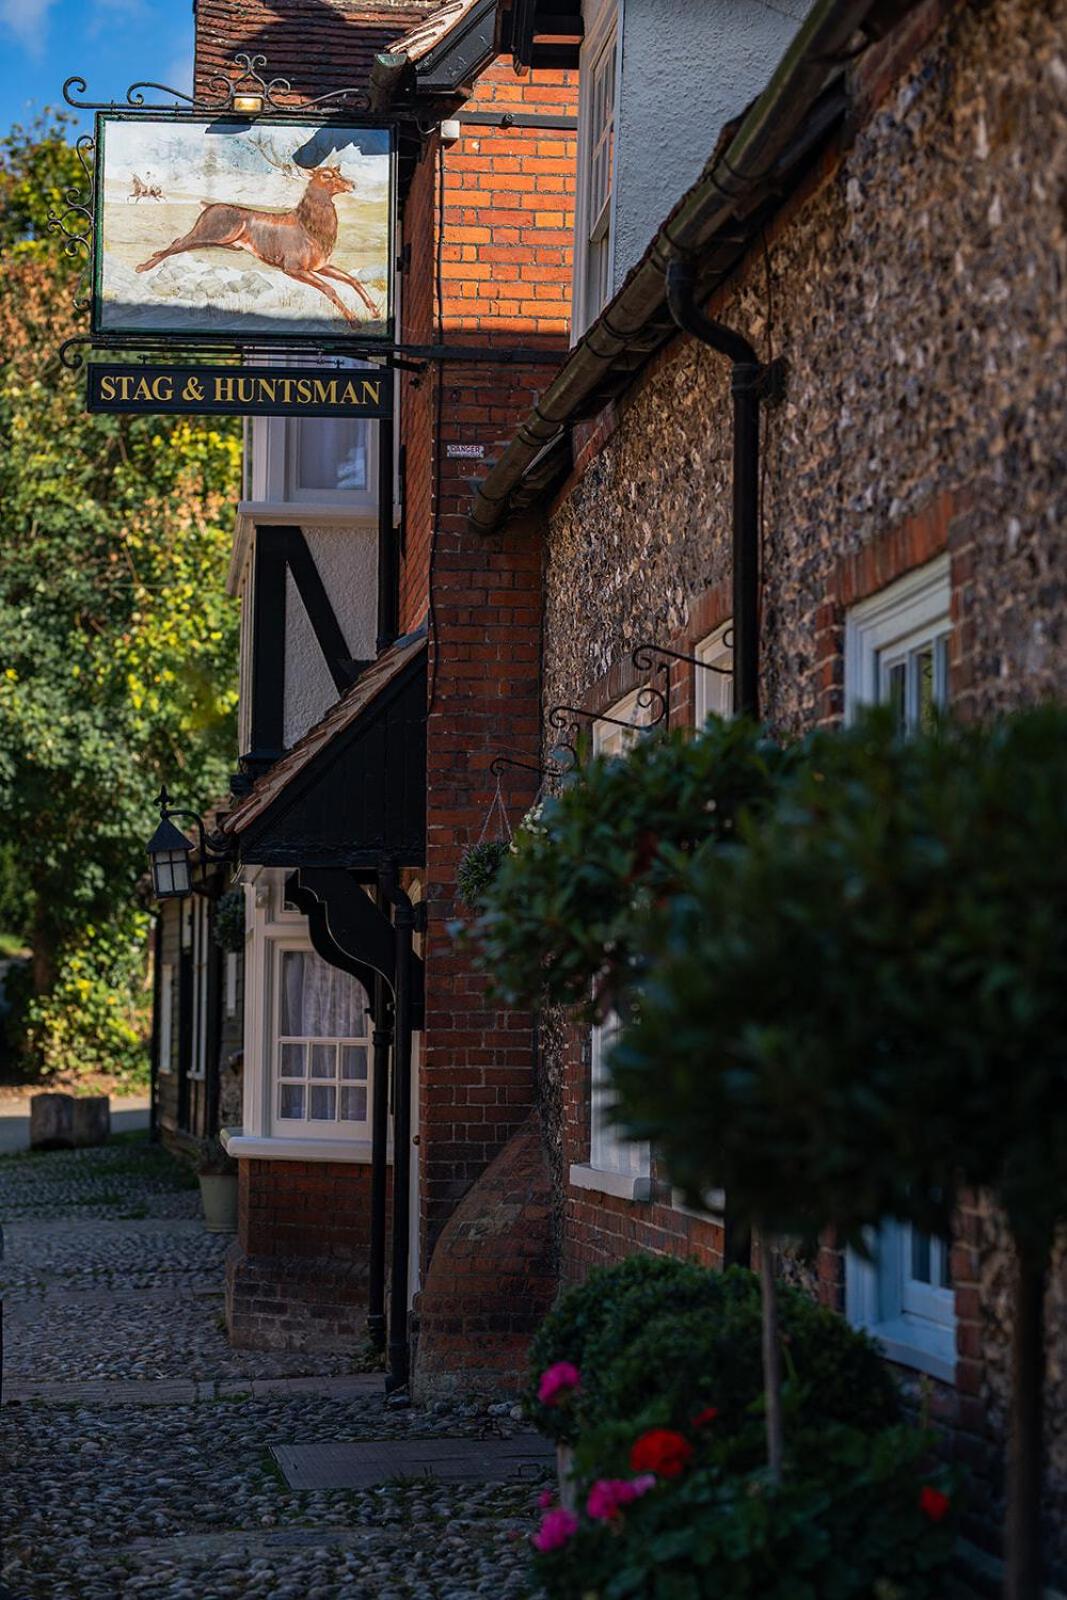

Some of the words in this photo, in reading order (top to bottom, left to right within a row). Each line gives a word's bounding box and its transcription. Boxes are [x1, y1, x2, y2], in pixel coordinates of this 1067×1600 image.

[100, 376, 174, 401] STAG
[182, 376, 205, 401] &
[214, 377, 380, 404] HUNTSMAN
[451, 445, 480, 453] DANGER
